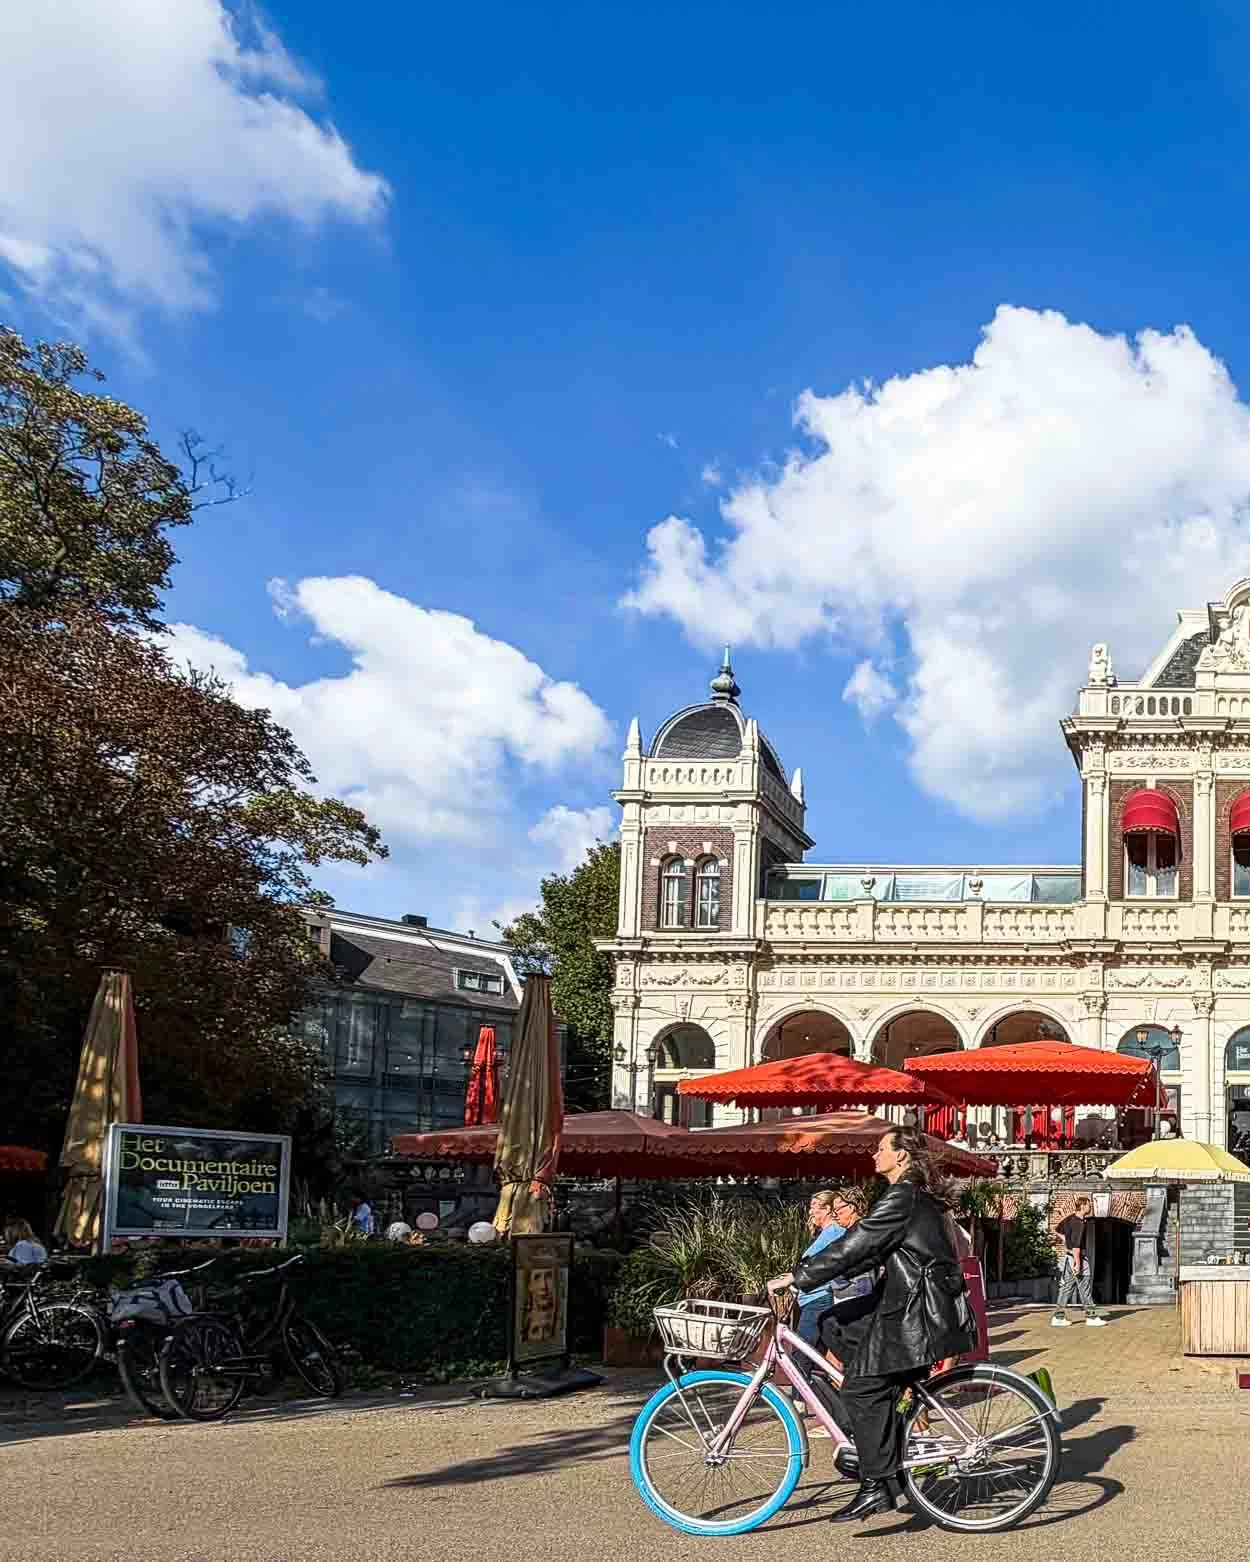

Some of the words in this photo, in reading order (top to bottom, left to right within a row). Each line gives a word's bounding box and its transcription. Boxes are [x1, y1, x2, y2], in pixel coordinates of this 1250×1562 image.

[122, 1134, 165, 1153] Het
[120, 1151, 277, 1177] Documentaire
[181, 1173, 276, 1197] Paviljoen
